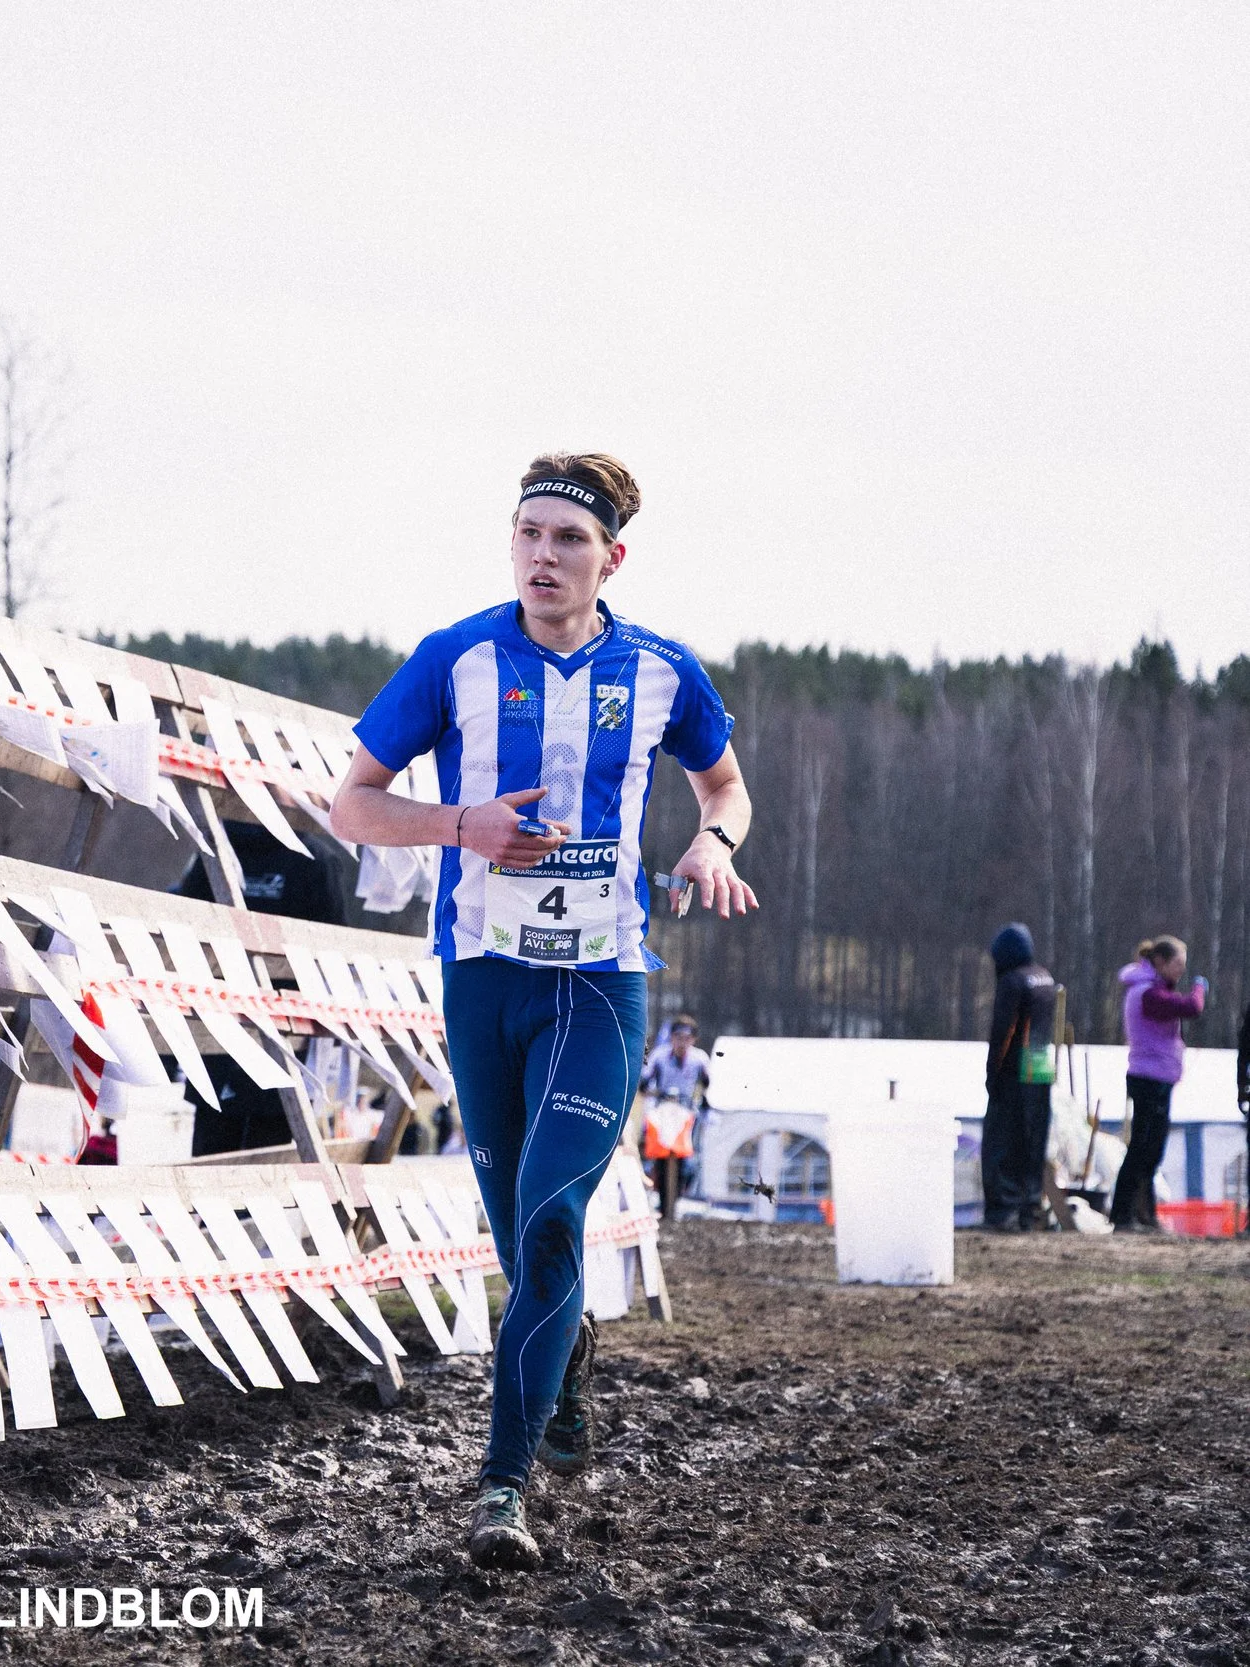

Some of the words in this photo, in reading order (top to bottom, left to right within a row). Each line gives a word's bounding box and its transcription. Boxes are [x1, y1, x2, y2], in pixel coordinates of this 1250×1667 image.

[523, 482, 595, 504] noname
[584, 625, 612, 656] noname
[622, 635, 683, 661] noname
[536, 847, 617, 866] neera
[538, 886, 567, 920] 4
[599, 883, 610, 898] 3
[525, 930, 573, 940] GODKÄNDA
[551, 1092, 569, 1101] IFK
[570, 1095, 618, 1120] Göteborg
[552, 1102, 610, 1128] Orientering
